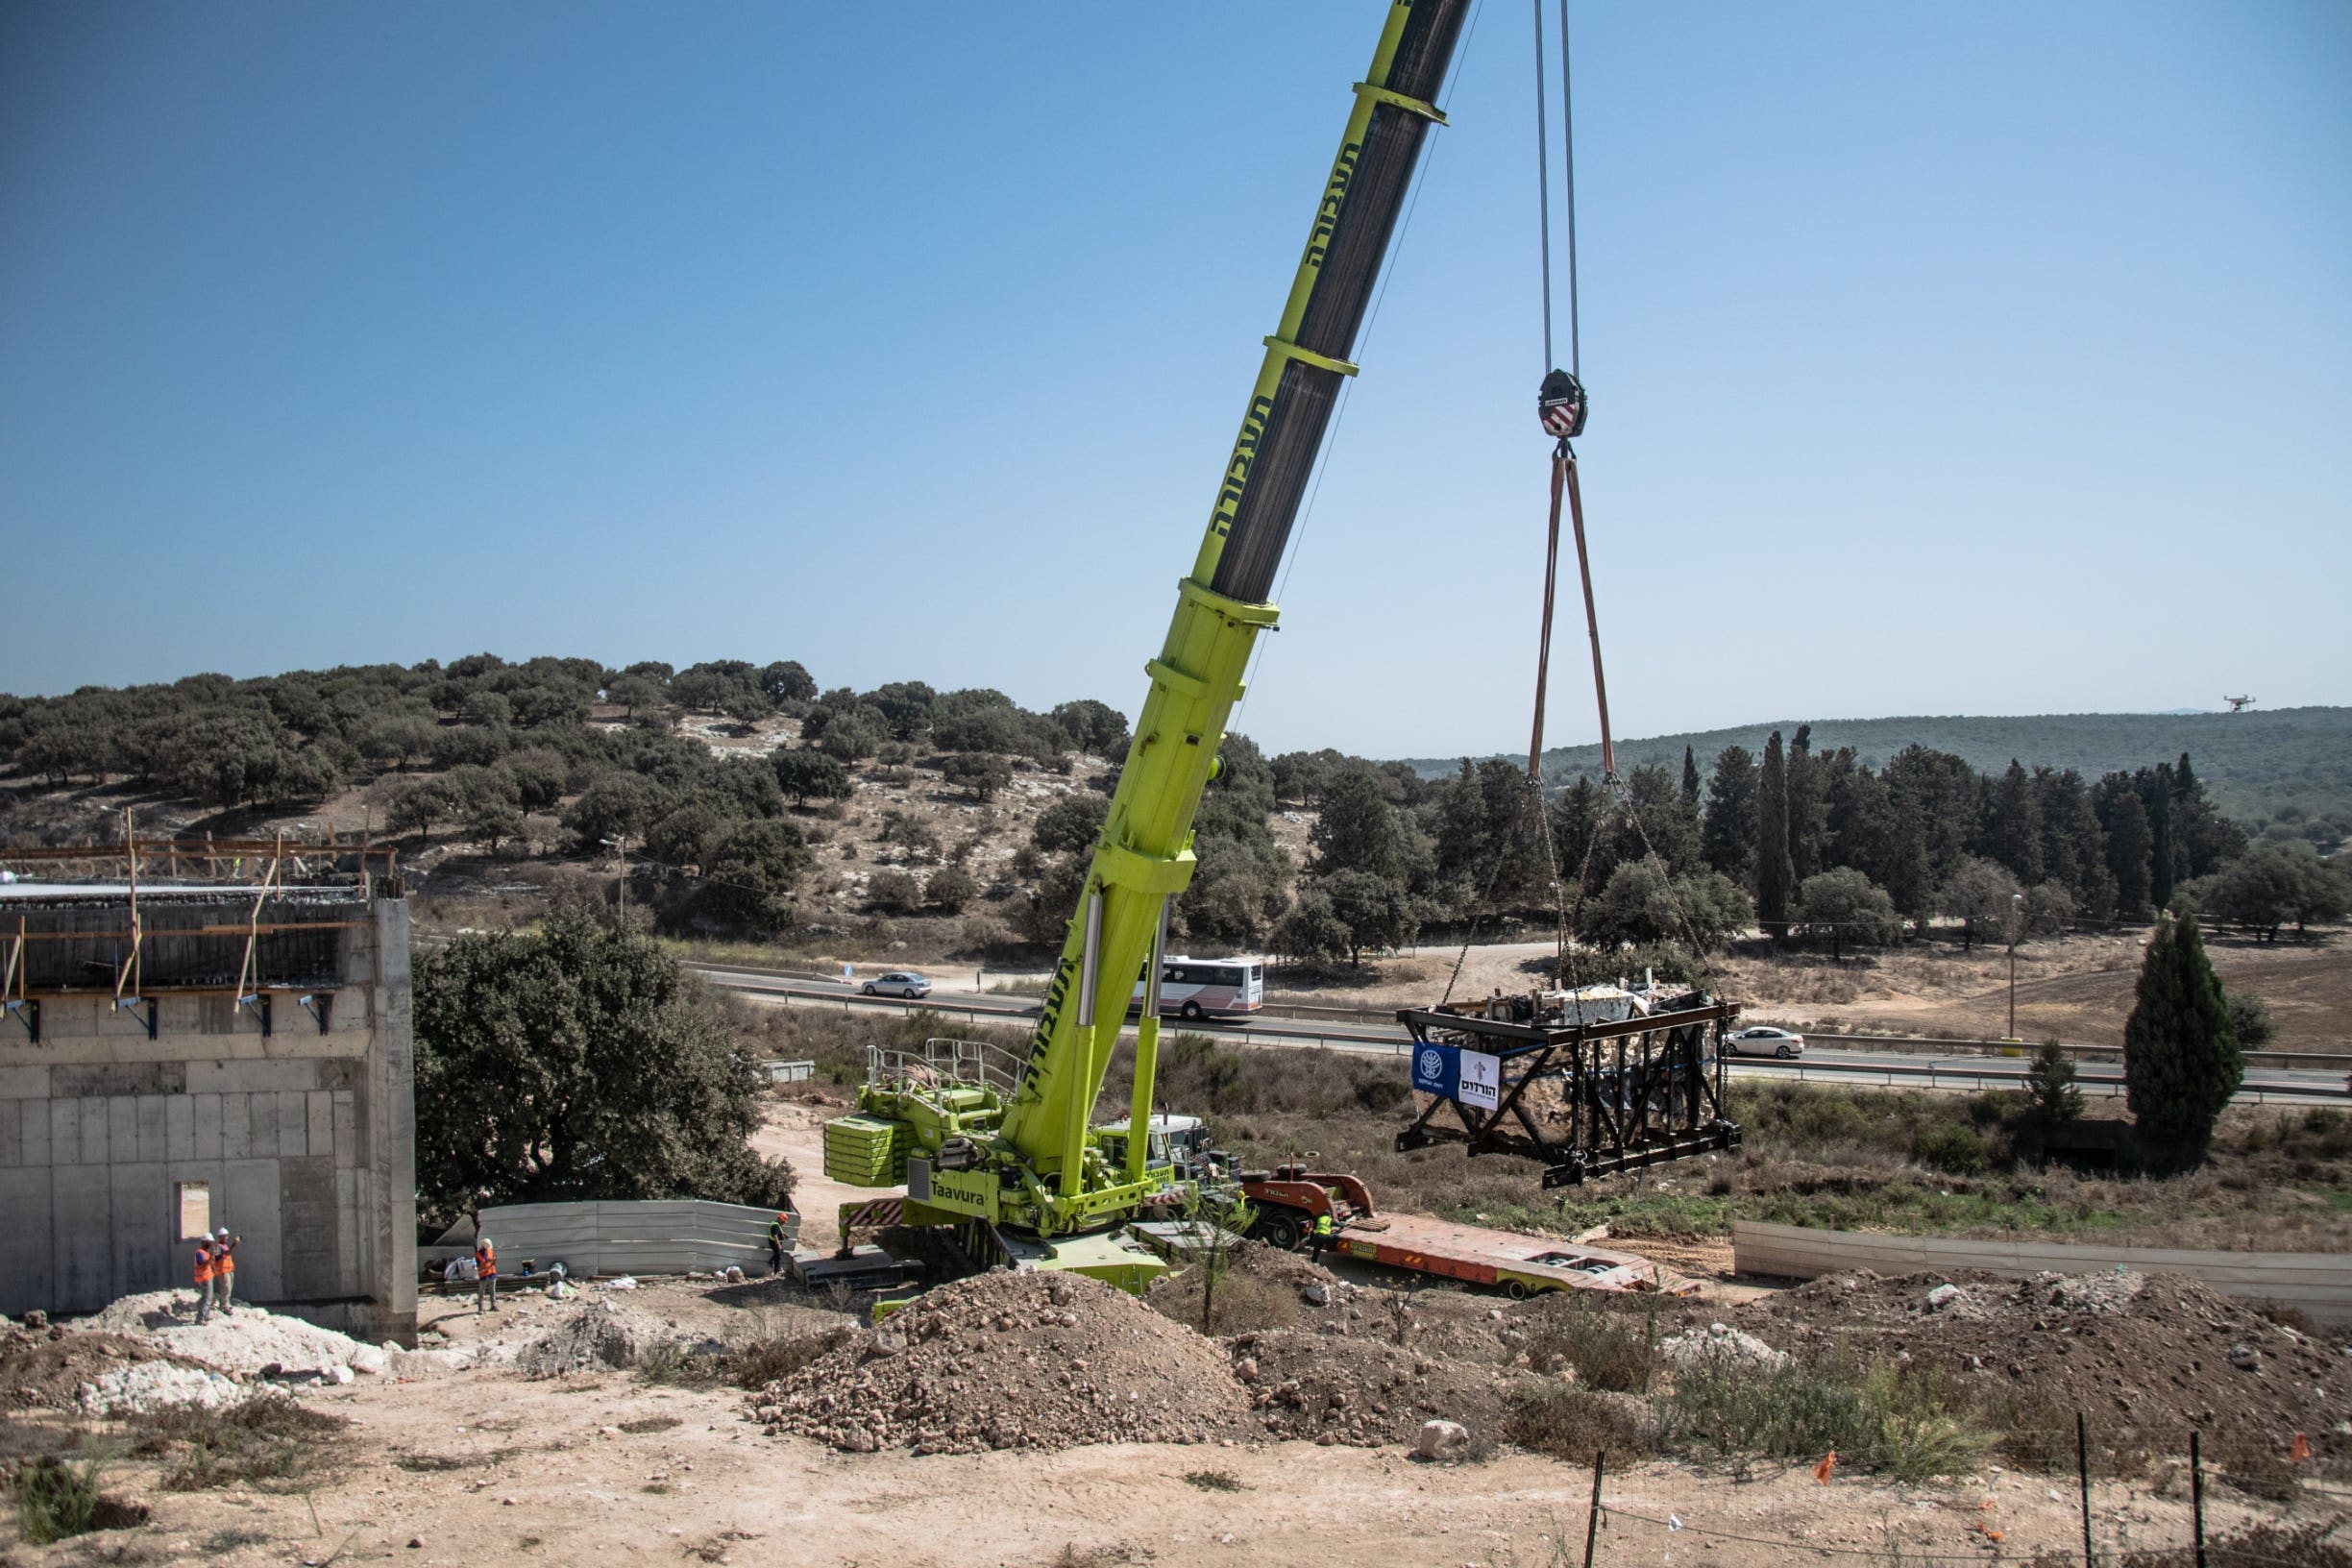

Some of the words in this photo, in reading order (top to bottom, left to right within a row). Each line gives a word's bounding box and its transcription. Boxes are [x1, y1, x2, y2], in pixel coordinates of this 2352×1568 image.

[1305, 142, 1360, 268] תעבורה
[1211, 395, 1273, 537] תעבורה
[1022, 958, 1075, 1091] תעבורה
[1461, 1080, 1496, 1097] הורדוס
[931, 1181, 984, 1206] Taavura
